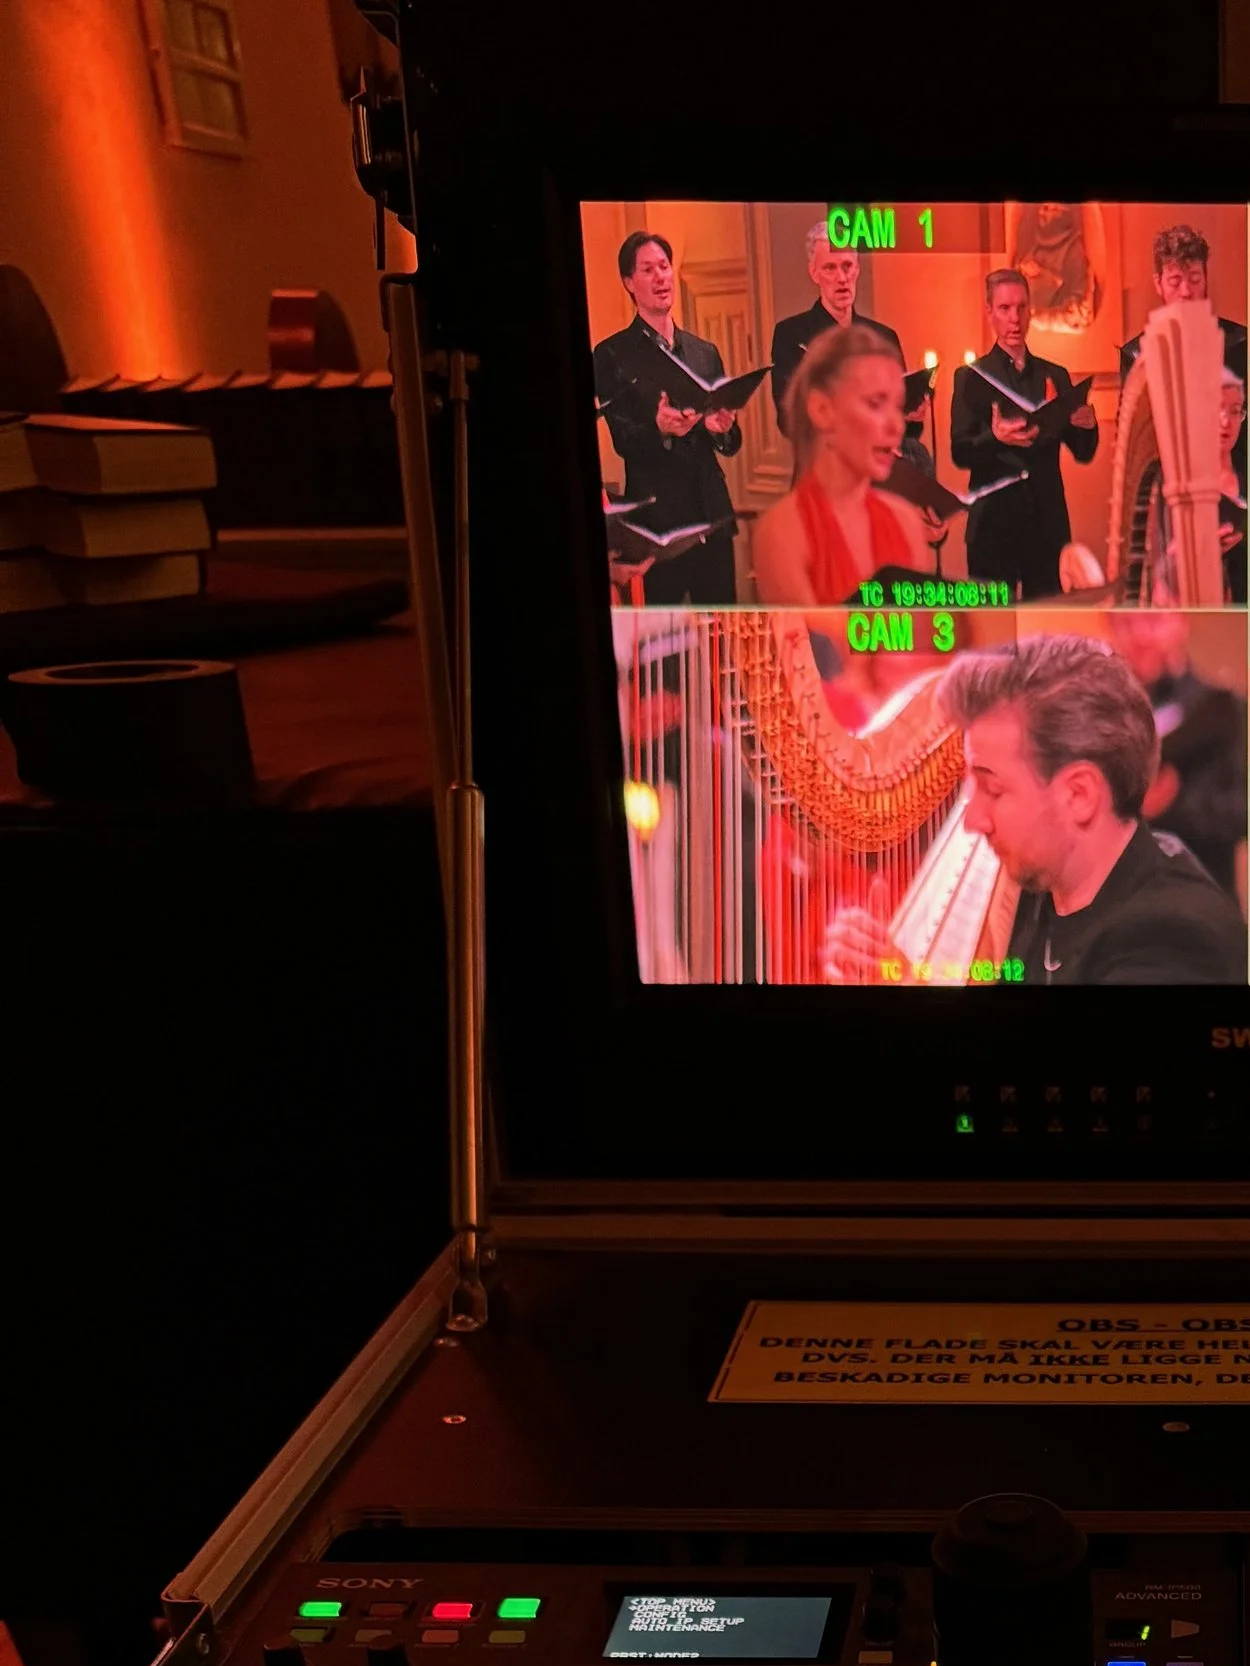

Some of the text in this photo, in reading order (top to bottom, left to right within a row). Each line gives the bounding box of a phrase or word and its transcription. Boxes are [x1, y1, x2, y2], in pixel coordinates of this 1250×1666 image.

[828, 208, 933, 248] CAM 1
[859, 581, 883, 606] TC
[848, 611, 955, 651] CAM 3
[1058, 1319, 1139, 1331] OBS
[760, 1338, 873, 1348] DENNE
[886, 1338, 986, 1349] FLADE
[998, 1340, 1080, 1349] SKAL
[1092, 1340, 1186, 1349] VÆRE
[802, 1354, 876, 1363] DVS.
[891, 1354, 955, 1363] DER
[970, 1352, 1017, 1364] MÅ
[1030, 1355, 1110, 1365] IKKE
[1122, 1355, 1221, 1364] LIGGE
[774, 1372, 970, 1383] BESKADIGE
[984, 1374, 1202, 1386] MONITOREN,
[316, 1578, 425, 1589] SONY
[1115, 1592, 1202, 1600] ADVANCED
[700, 1617, 745, 1625] SETUP
